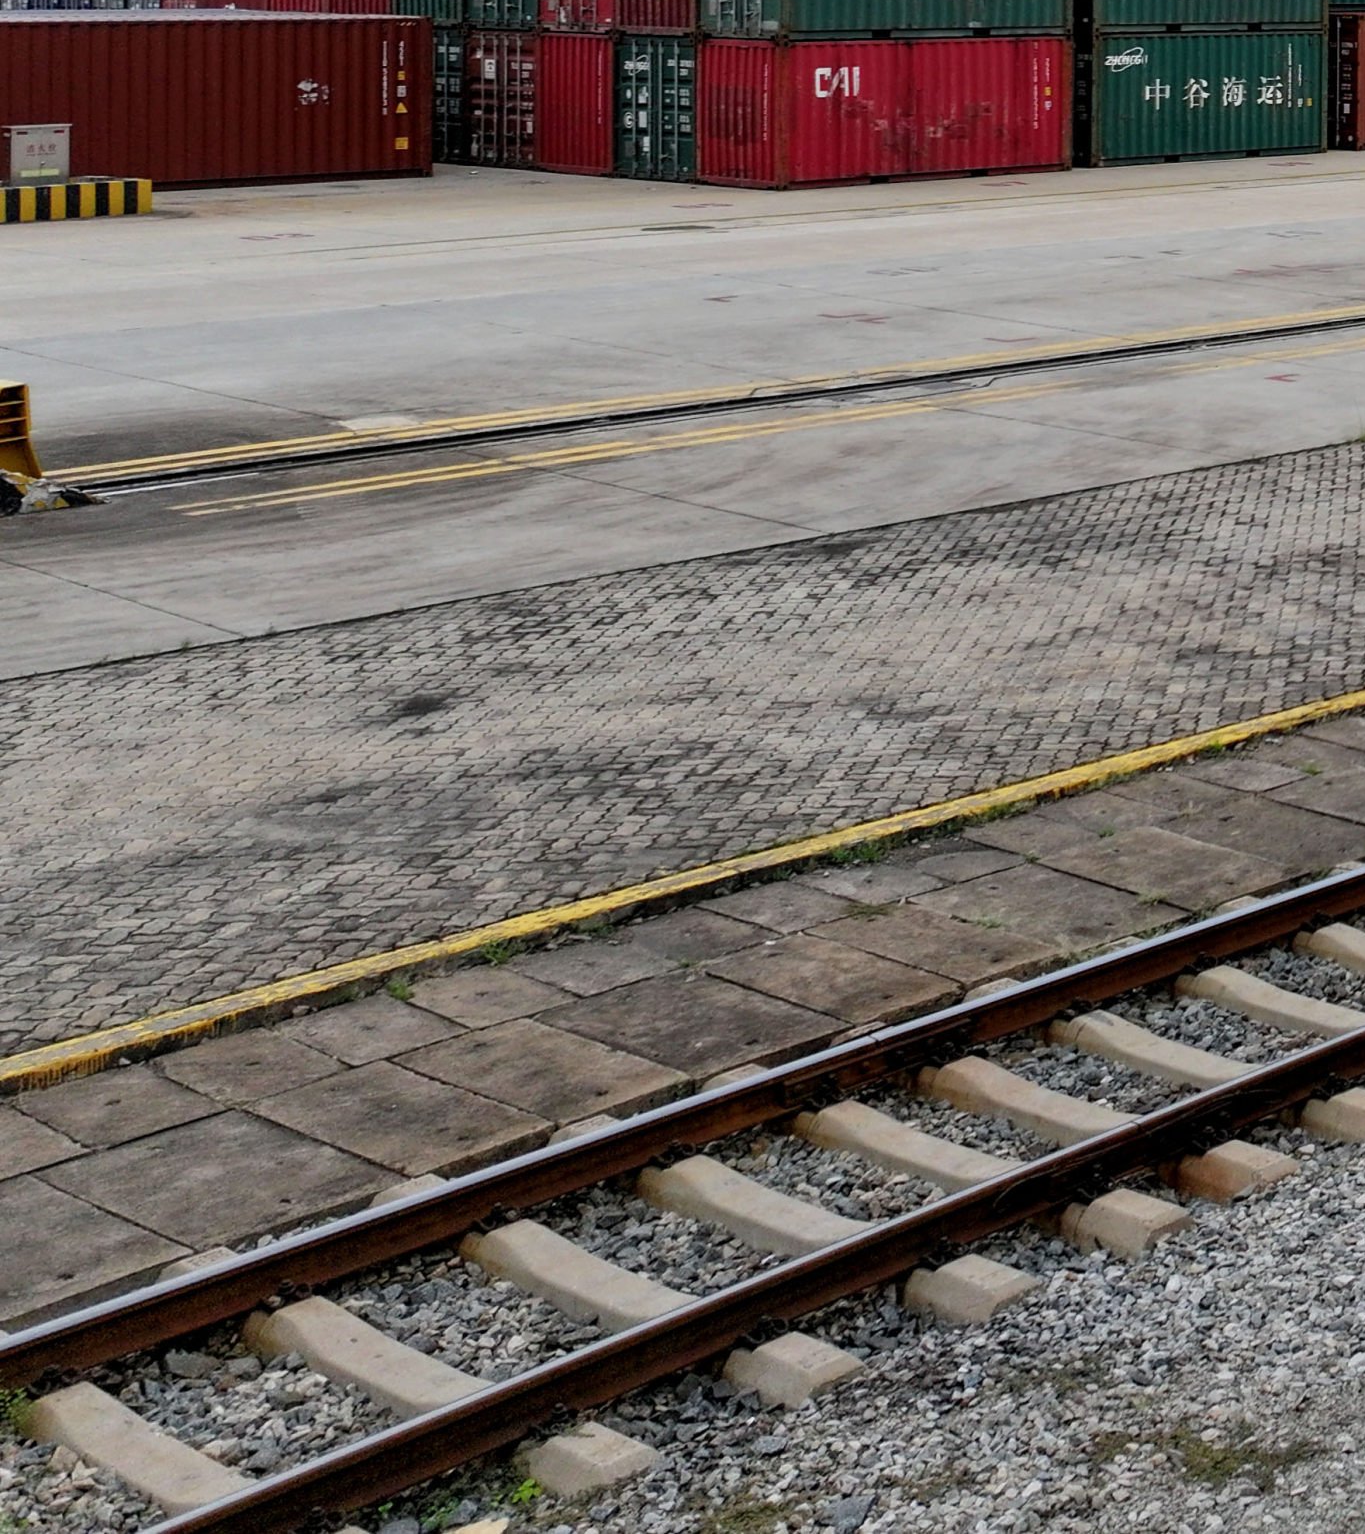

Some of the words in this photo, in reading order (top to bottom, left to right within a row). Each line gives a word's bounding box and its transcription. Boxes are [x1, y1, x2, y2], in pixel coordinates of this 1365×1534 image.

[815, 66, 860, 98] CAI
[1144, 76, 1284, 111] 中谷海运
